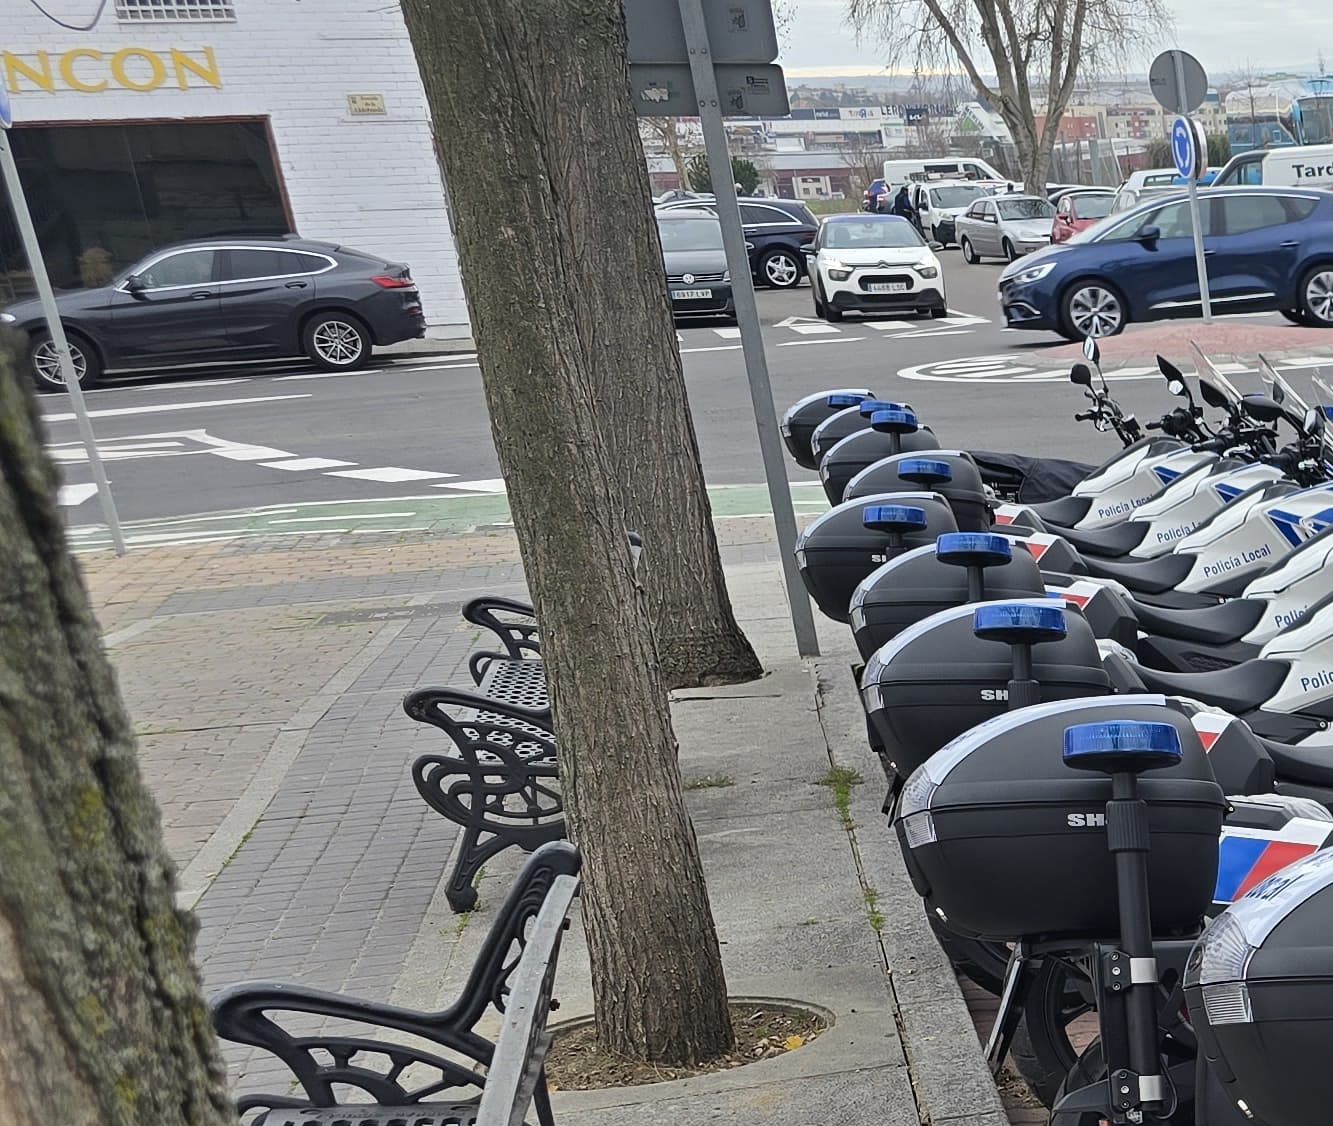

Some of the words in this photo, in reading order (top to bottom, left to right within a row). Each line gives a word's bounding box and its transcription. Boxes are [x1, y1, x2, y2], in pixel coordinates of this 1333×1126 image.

[1098, 502, 1130, 519] Policía
[1156, 524, 1191, 543] Policía
[1203, 556, 1241, 577] Policía
[1241, 543, 1271, 563] Local
[1067, 813, 1108, 827] SH
